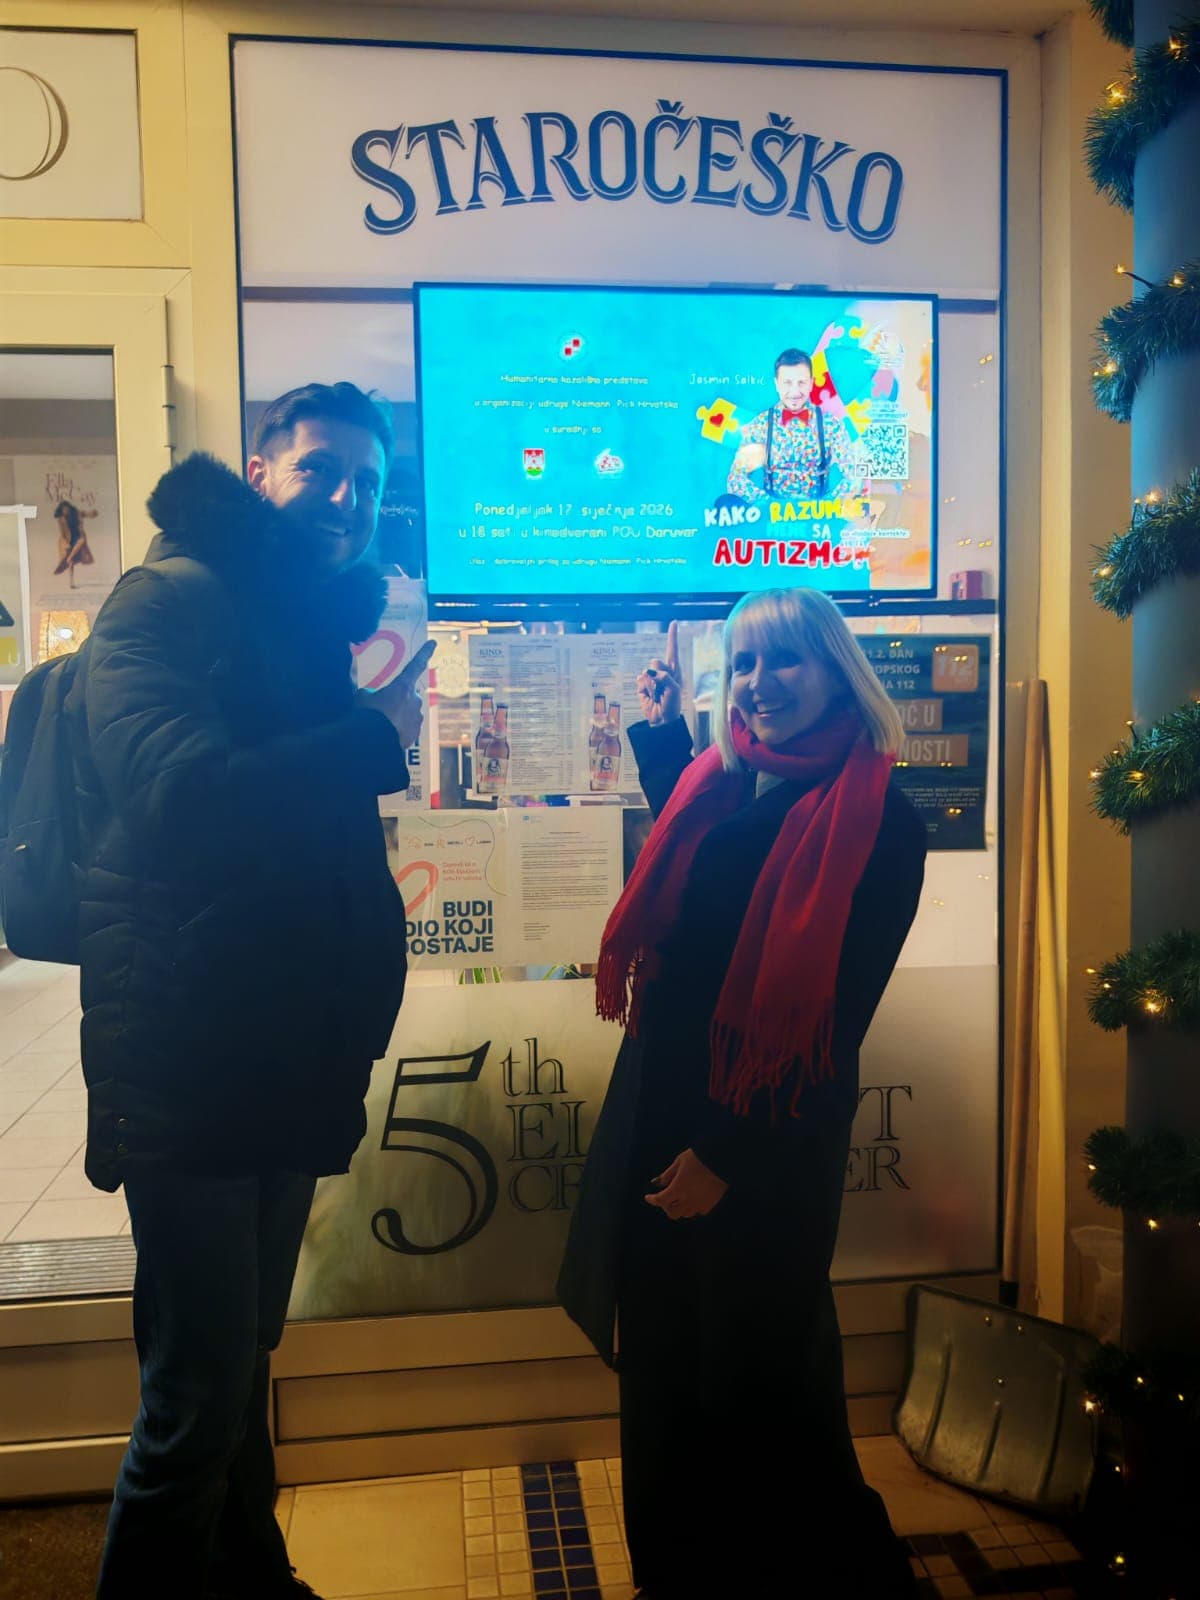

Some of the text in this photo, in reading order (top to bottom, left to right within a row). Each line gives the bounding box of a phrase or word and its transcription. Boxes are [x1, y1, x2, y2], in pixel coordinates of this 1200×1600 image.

[351, 98, 904, 245] STAROČEŠKO
[689, 373, 730, 386] Jasmin
[639, 503, 674, 517] 2026
[704, 505, 762, 528] KAKO
[459, 528, 466, 538] u
[521, 528, 528, 538] u
[645, 526, 698, 538] Daruvar
[812, 523, 831, 540] SA
[889, 648, 914, 659] DAN
[875, 664, 920, 674] OPSKOG
[897, 680, 915, 689] 112
[923, 704, 934, 727] U
[899, 739, 950, 762] NOSTI
[443, 900, 493, 918] BUDI
[405, 918, 493, 937] DIO KOJI
[406, 936, 494, 955] OSTAJE
[371, 1037, 569, 1256] 5 th
